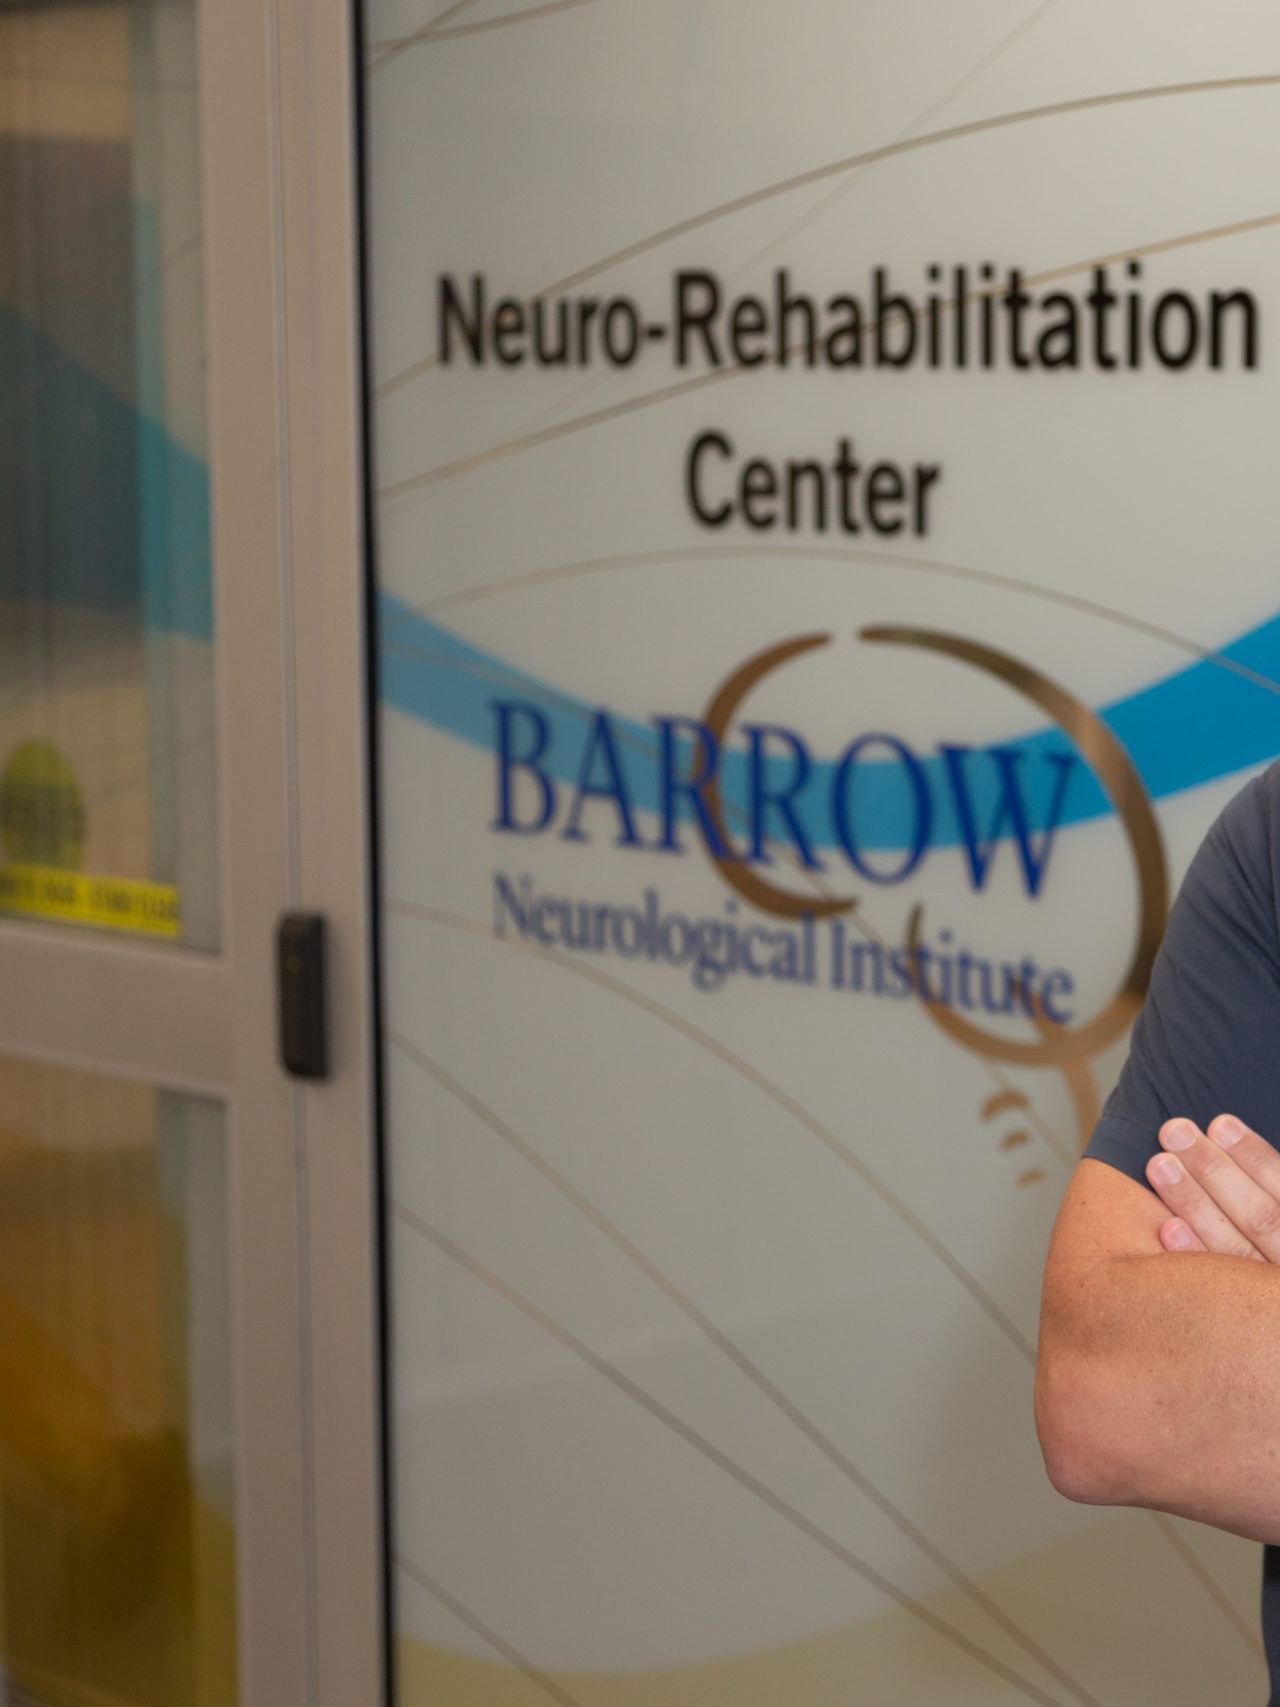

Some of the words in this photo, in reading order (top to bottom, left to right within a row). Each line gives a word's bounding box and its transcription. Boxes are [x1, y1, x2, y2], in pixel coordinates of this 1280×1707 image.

[436, 258, 1261, 372] Neuro-Rehabilitation
[684, 428, 941, 537] Center
[488, 699, 1076, 900] BARROW
[490, 872, 817, 993] Neurological
[830, 917, 1074, 1024] Institute
